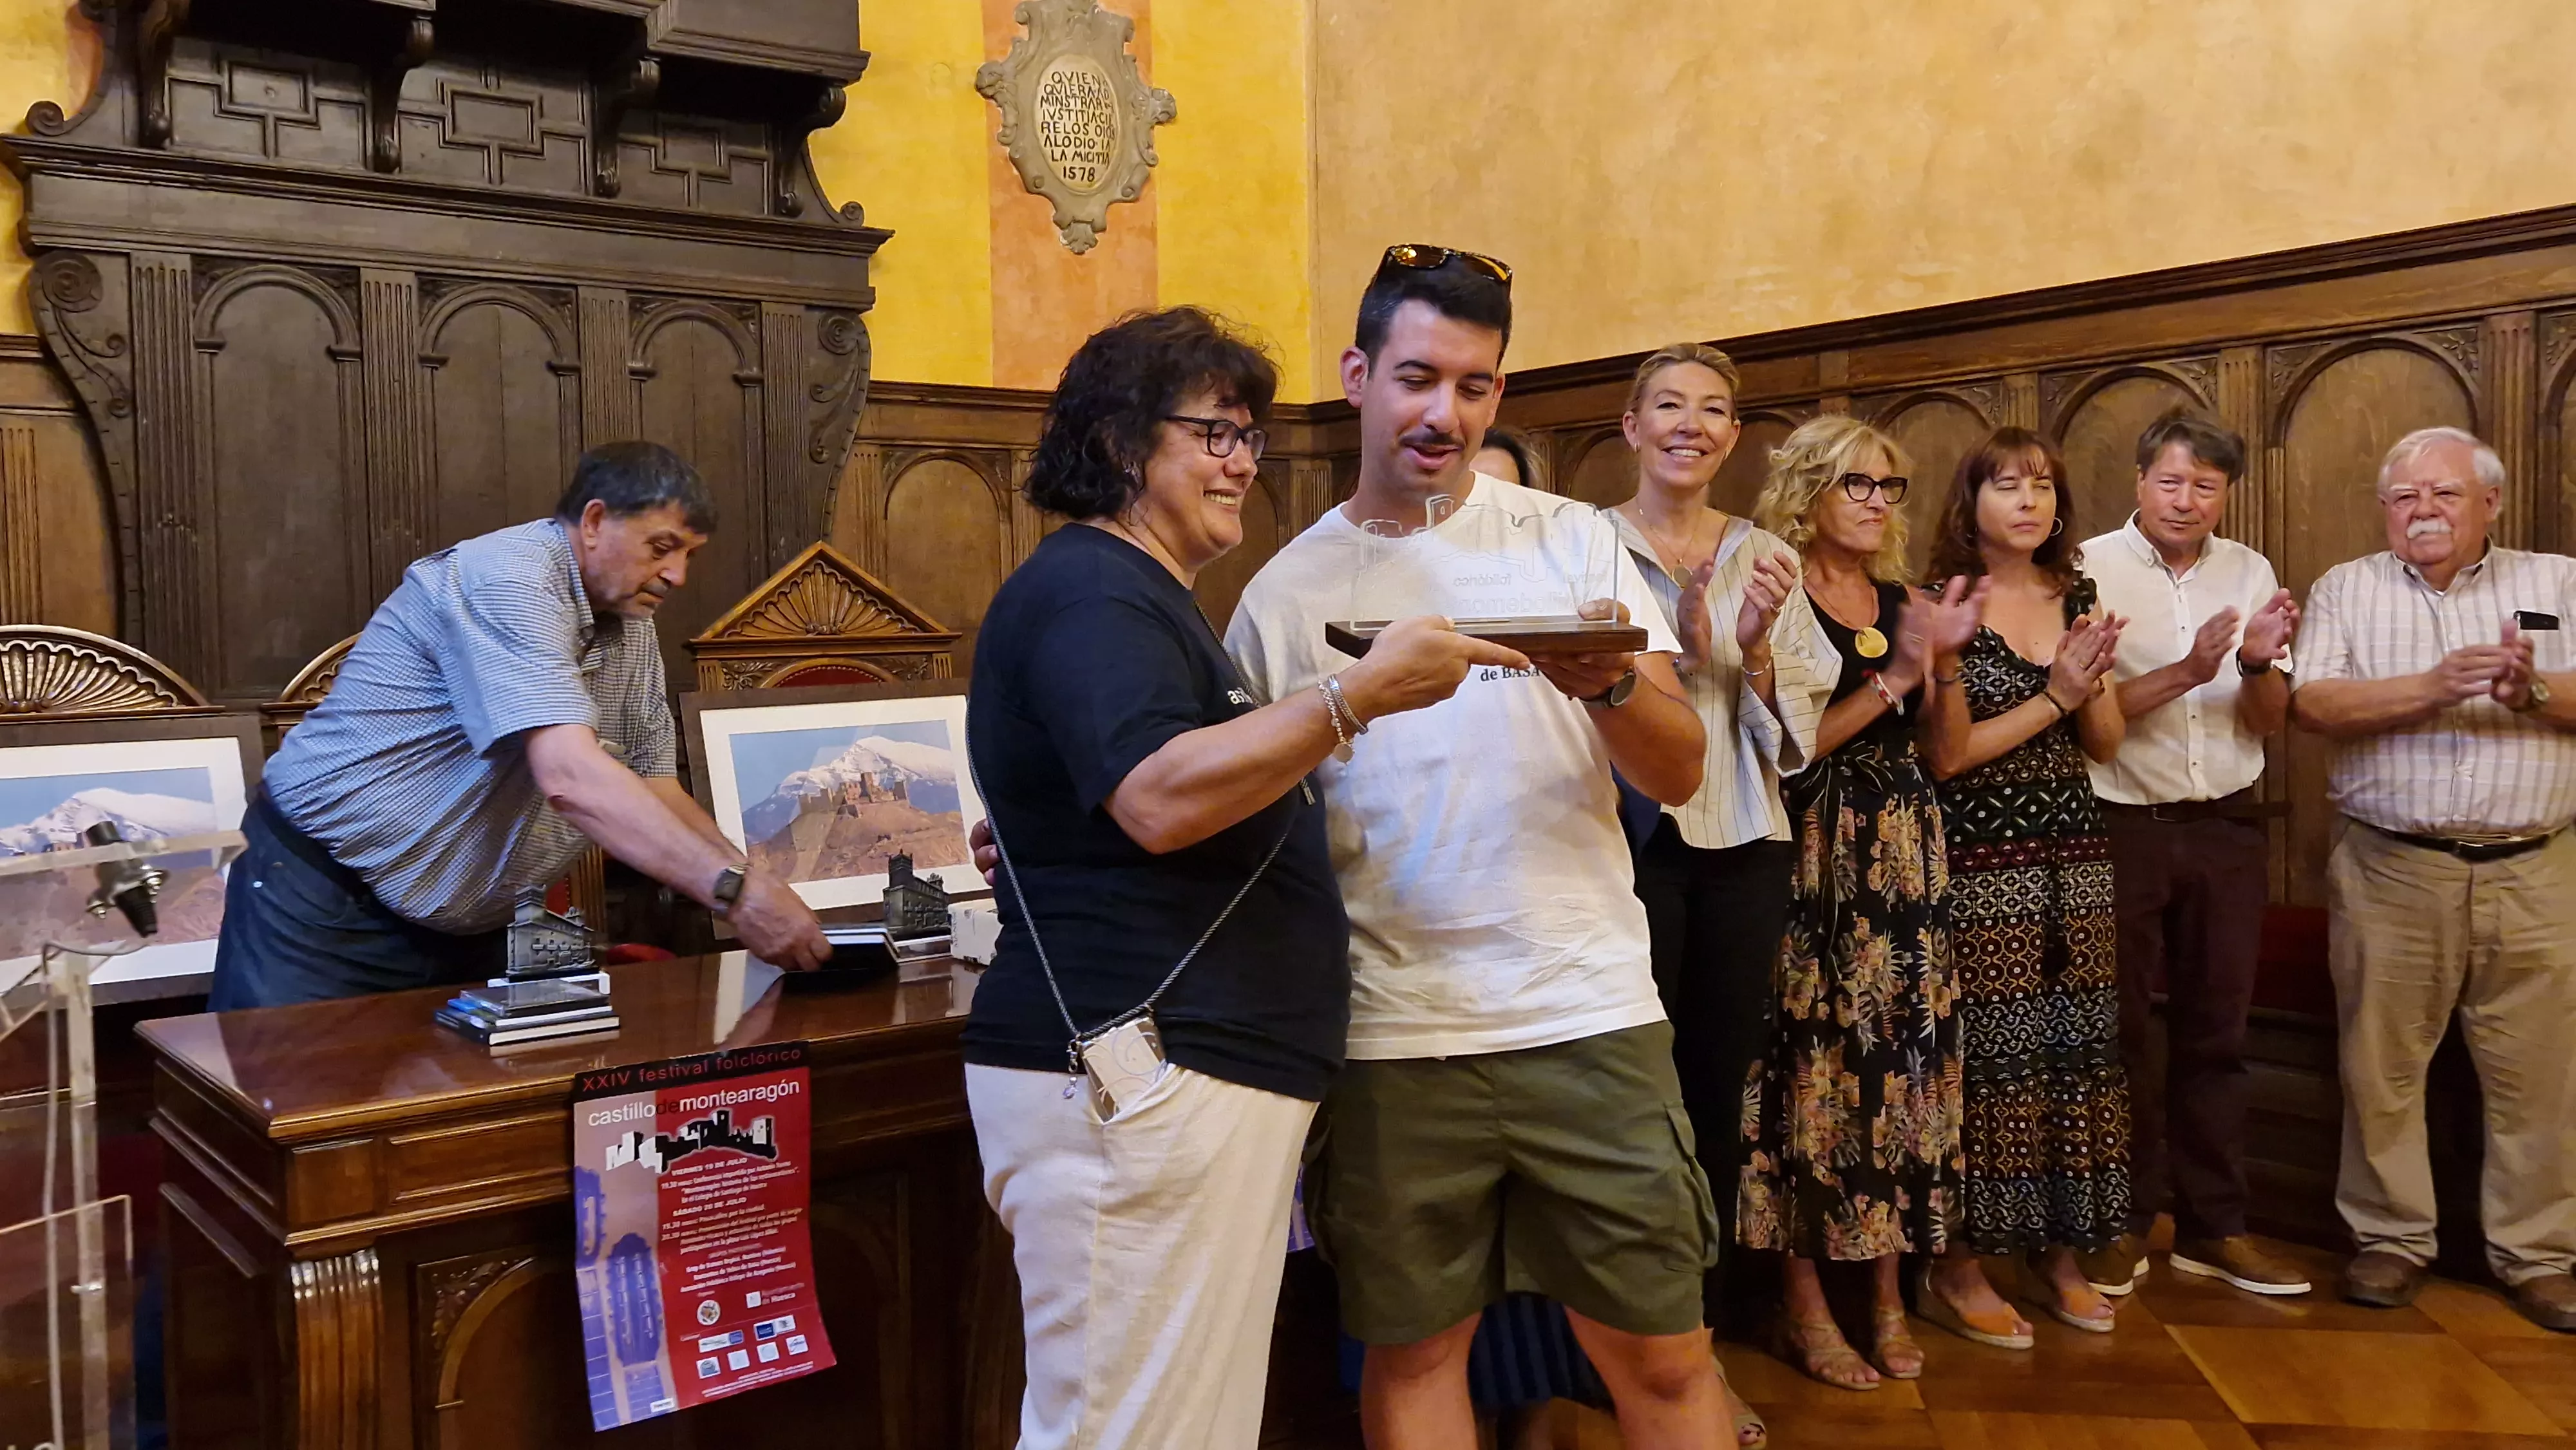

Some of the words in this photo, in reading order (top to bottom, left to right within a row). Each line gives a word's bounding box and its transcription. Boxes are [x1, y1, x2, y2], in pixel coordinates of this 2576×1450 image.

[1051, 71, 1101, 86] QVIEN
[1051, 149, 1068, 162] LA
[1063, 165, 1095, 183] 1578
[1480, 668, 1498, 682] de
[582, 1070, 630, 1092] XXIV
[639, 1060, 708, 1083] festival
[716, 1047, 802, 1070] folclórico
